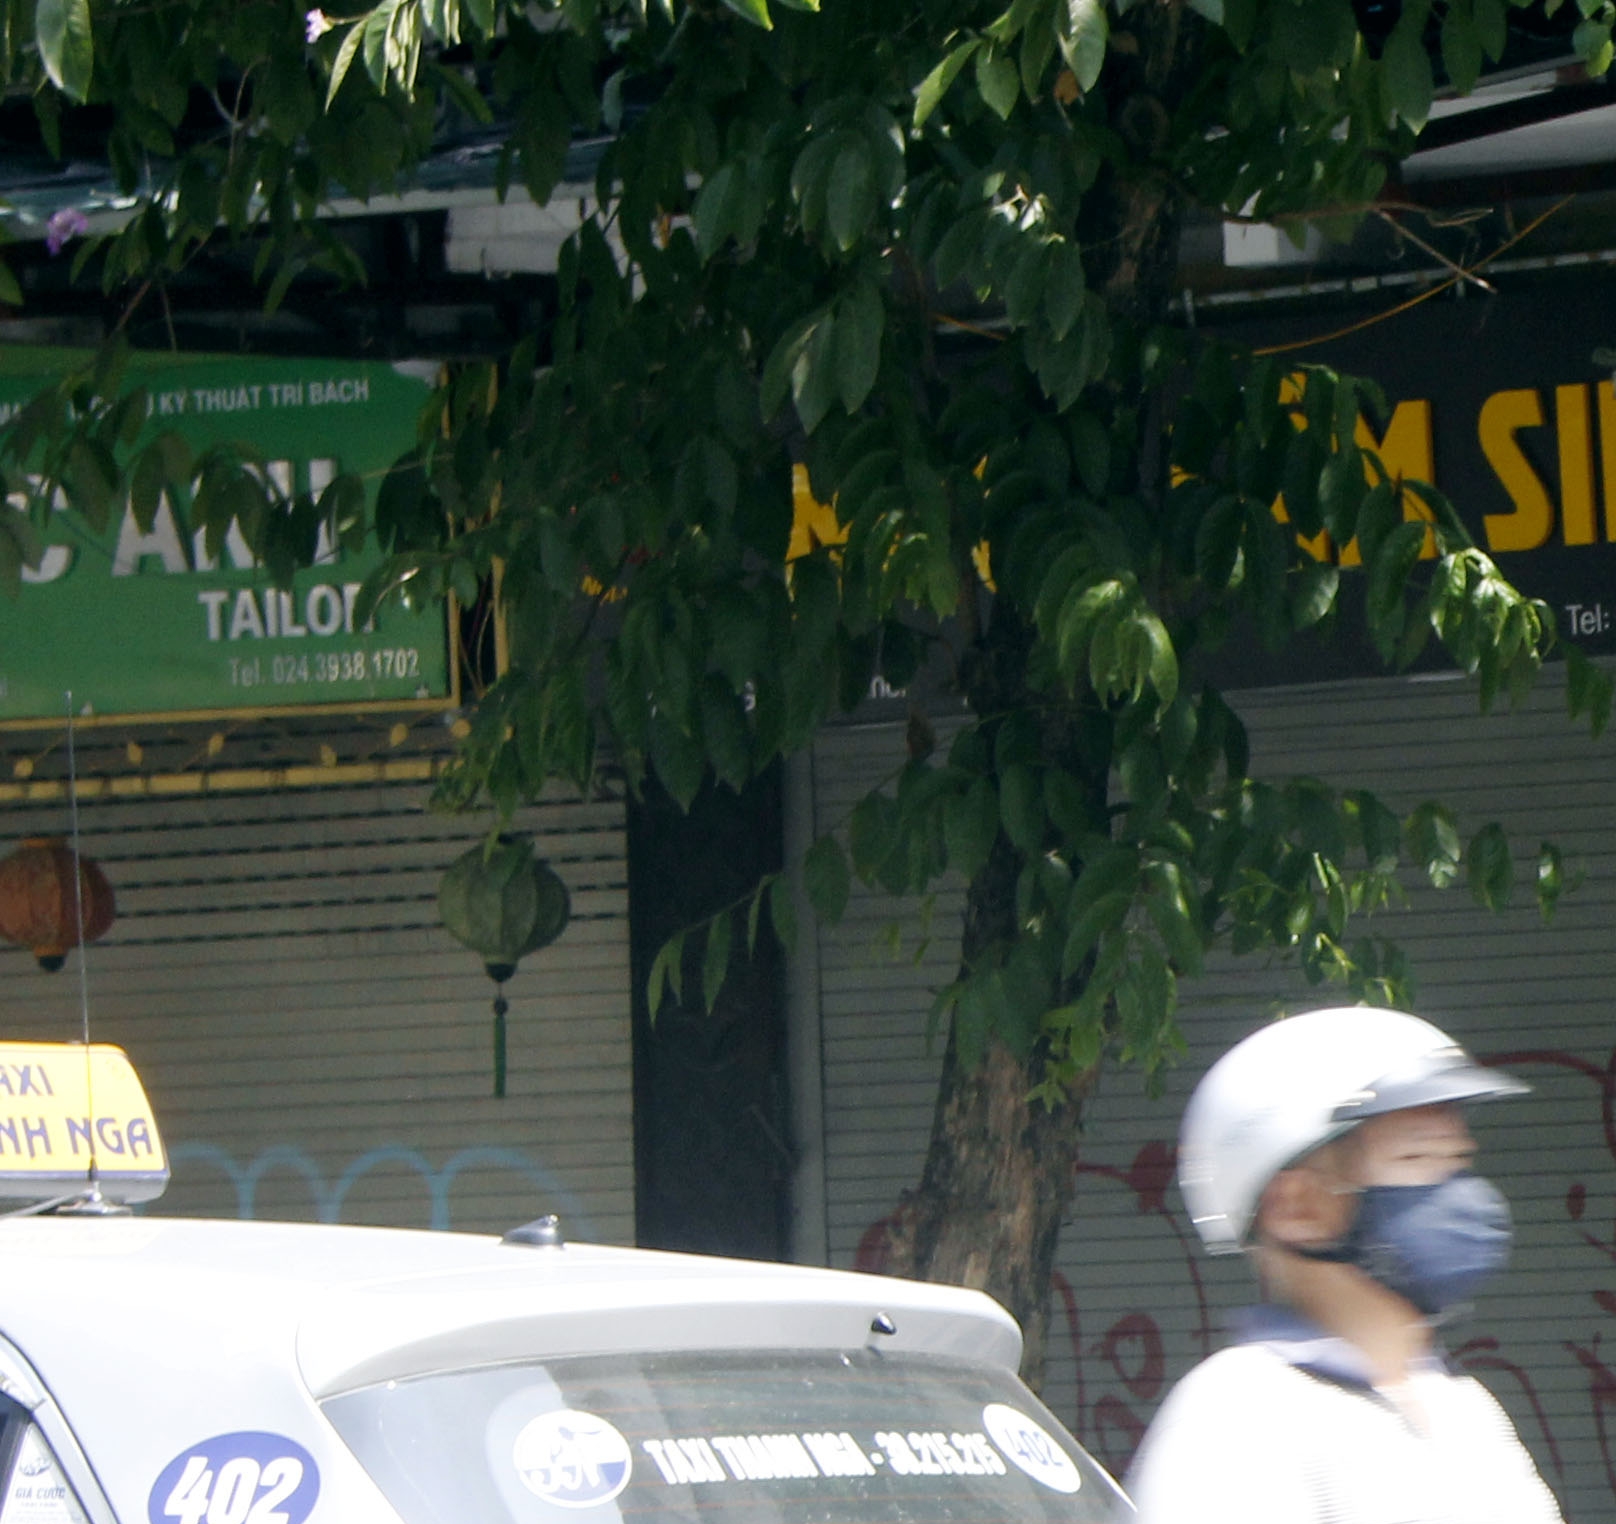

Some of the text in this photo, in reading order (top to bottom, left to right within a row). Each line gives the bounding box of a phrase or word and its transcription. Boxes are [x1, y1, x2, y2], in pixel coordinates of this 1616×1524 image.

[1566, 602, 1611, 636] Tel:
[65, 1116, 154, 1159] NGA
[642, 1439, 727, 1485] TAXI
